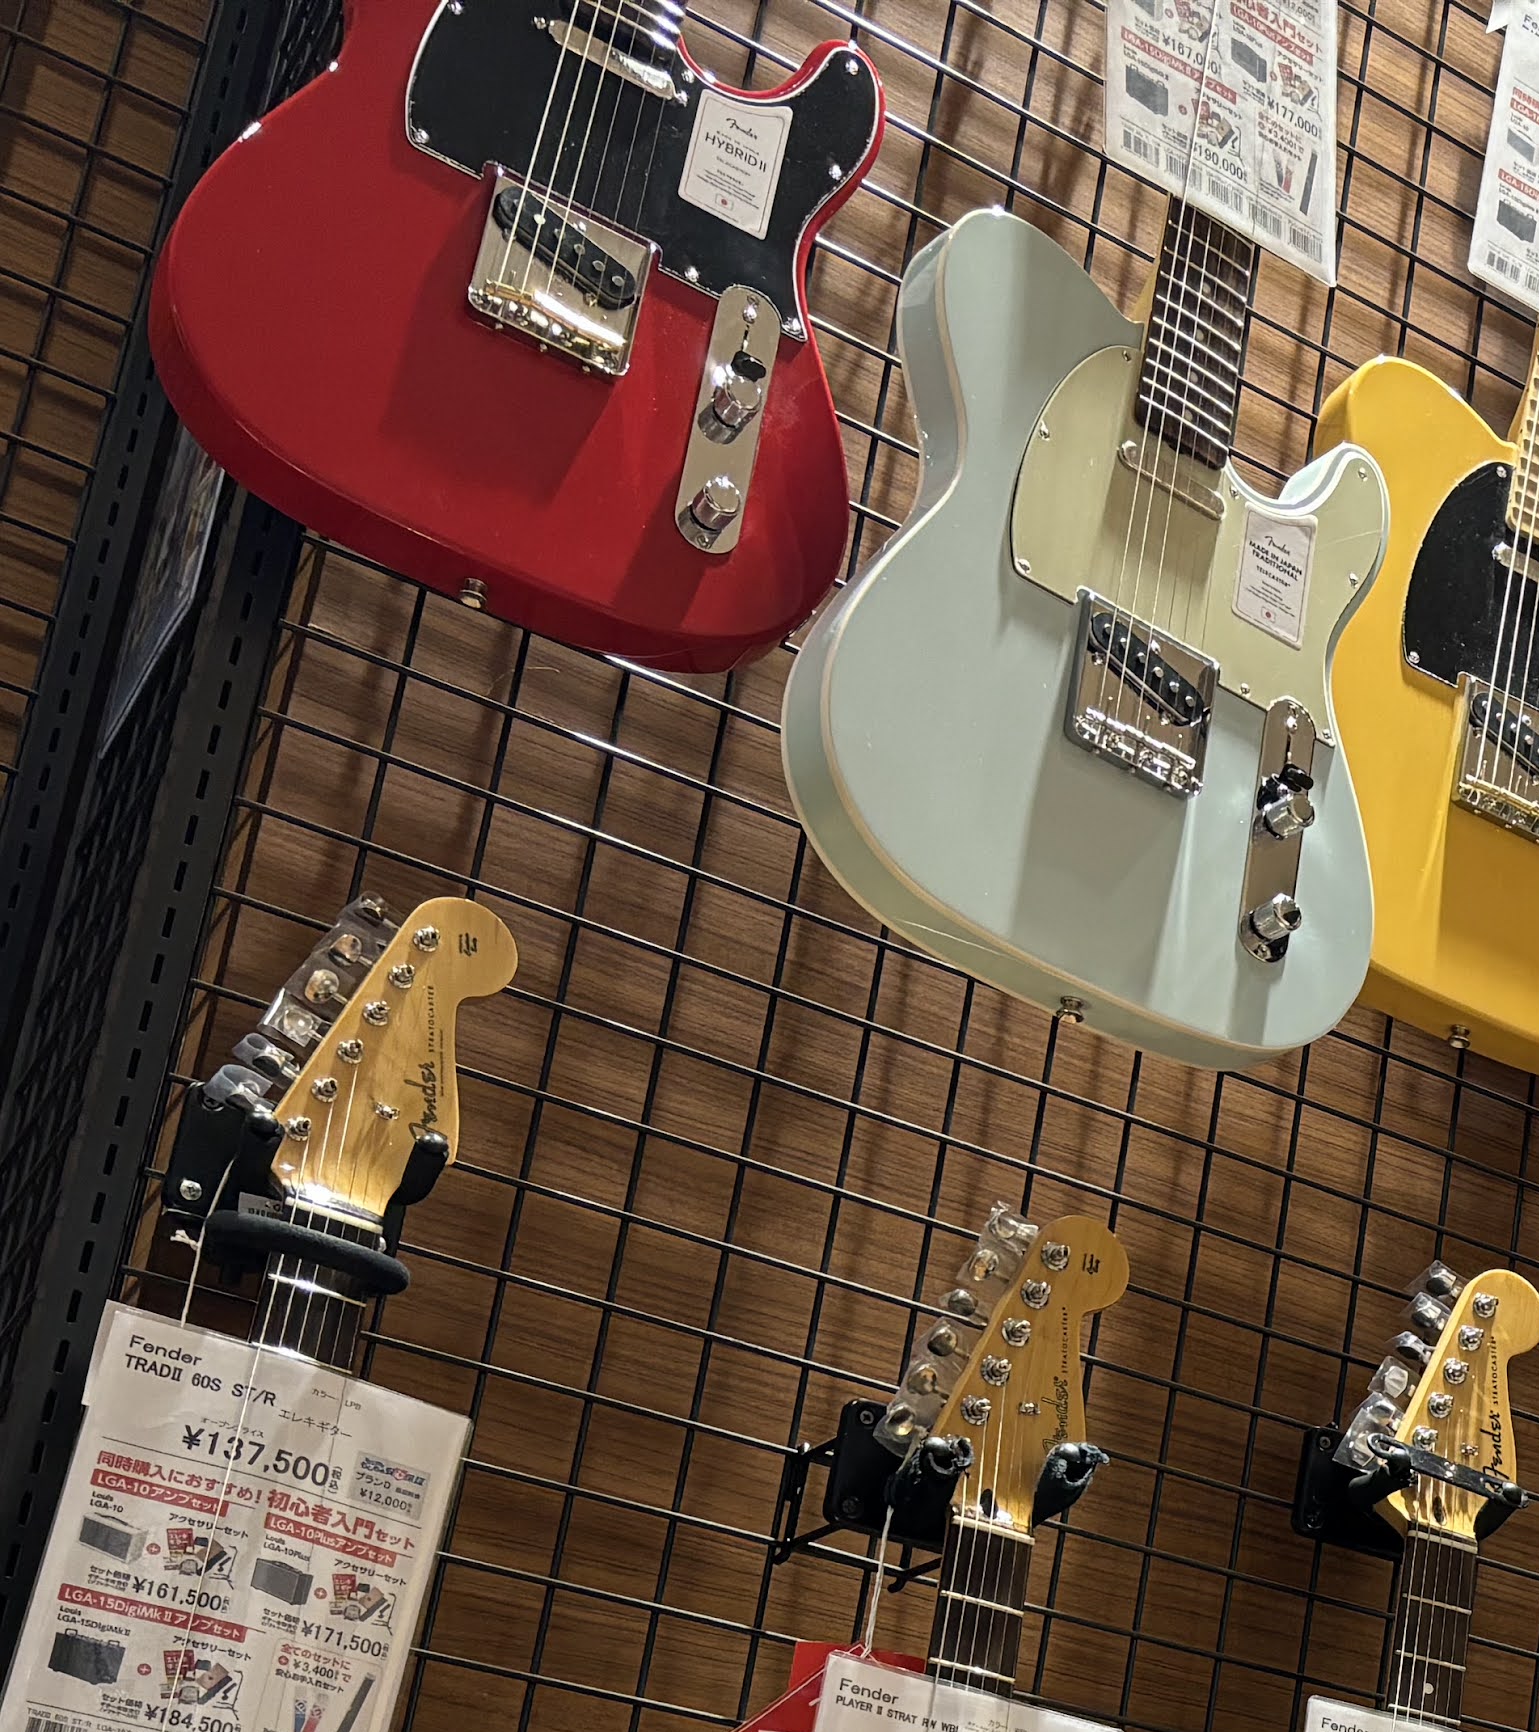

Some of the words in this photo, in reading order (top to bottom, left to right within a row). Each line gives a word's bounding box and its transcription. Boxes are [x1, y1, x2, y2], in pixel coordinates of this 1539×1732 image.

[726, 117, 758, 140] Fender
[705, 132, 757, 166] HYBRID
[129, 1334, 202, 1366] Fender
[192, 1373, 221, 1392] 60S
[232, 1384, 276, 1407] ST/R
[182, 1424, 329, 1487] ¥137,500
[1480, 1410, 1510, 1480] Fender
[267, 1487, 416, 1552] 初心者入門セット
[333, 1558, 407, 1587] アクセサリーセット
[132, 1575, 224, 1611] ¥161,500
[279, 1641, 353, 1671] 全てのセットに
[300, 1620, 384, 1658] ¥171,500
[840, 1678, 899, 1706] Fender
